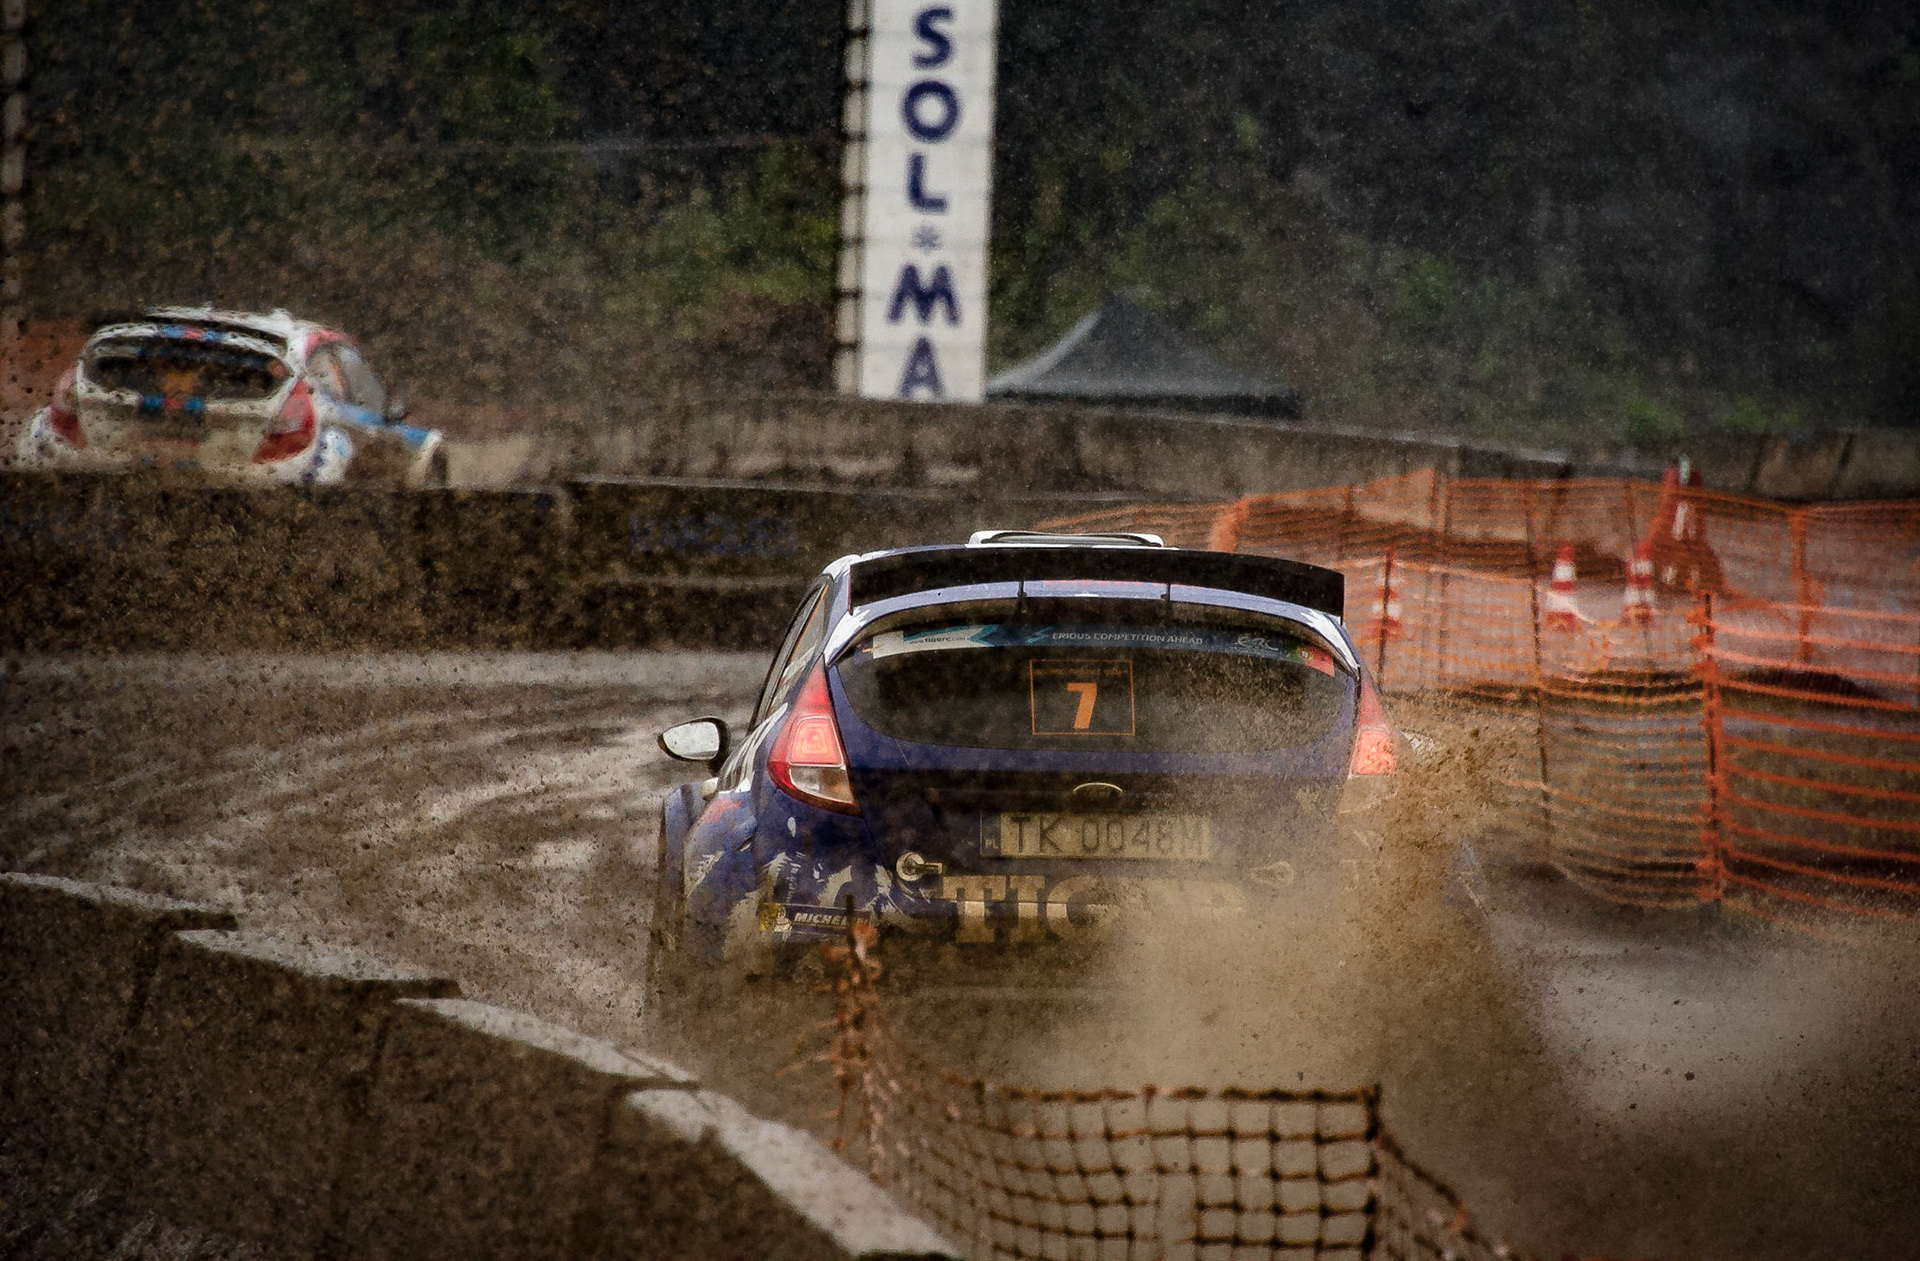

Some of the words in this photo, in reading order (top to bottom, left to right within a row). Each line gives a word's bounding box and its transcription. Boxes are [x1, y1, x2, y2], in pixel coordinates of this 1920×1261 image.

[1094, 632, 1165, 643] COMPETITION
[1166, 635, 1203, 645] AHEAD
[1066, 682, 1098, 730] 7
[1010, 815, 1064, 852] TK
[984, 838, 999, 850] PL
[794, 911, 870, 927] MICHEL
